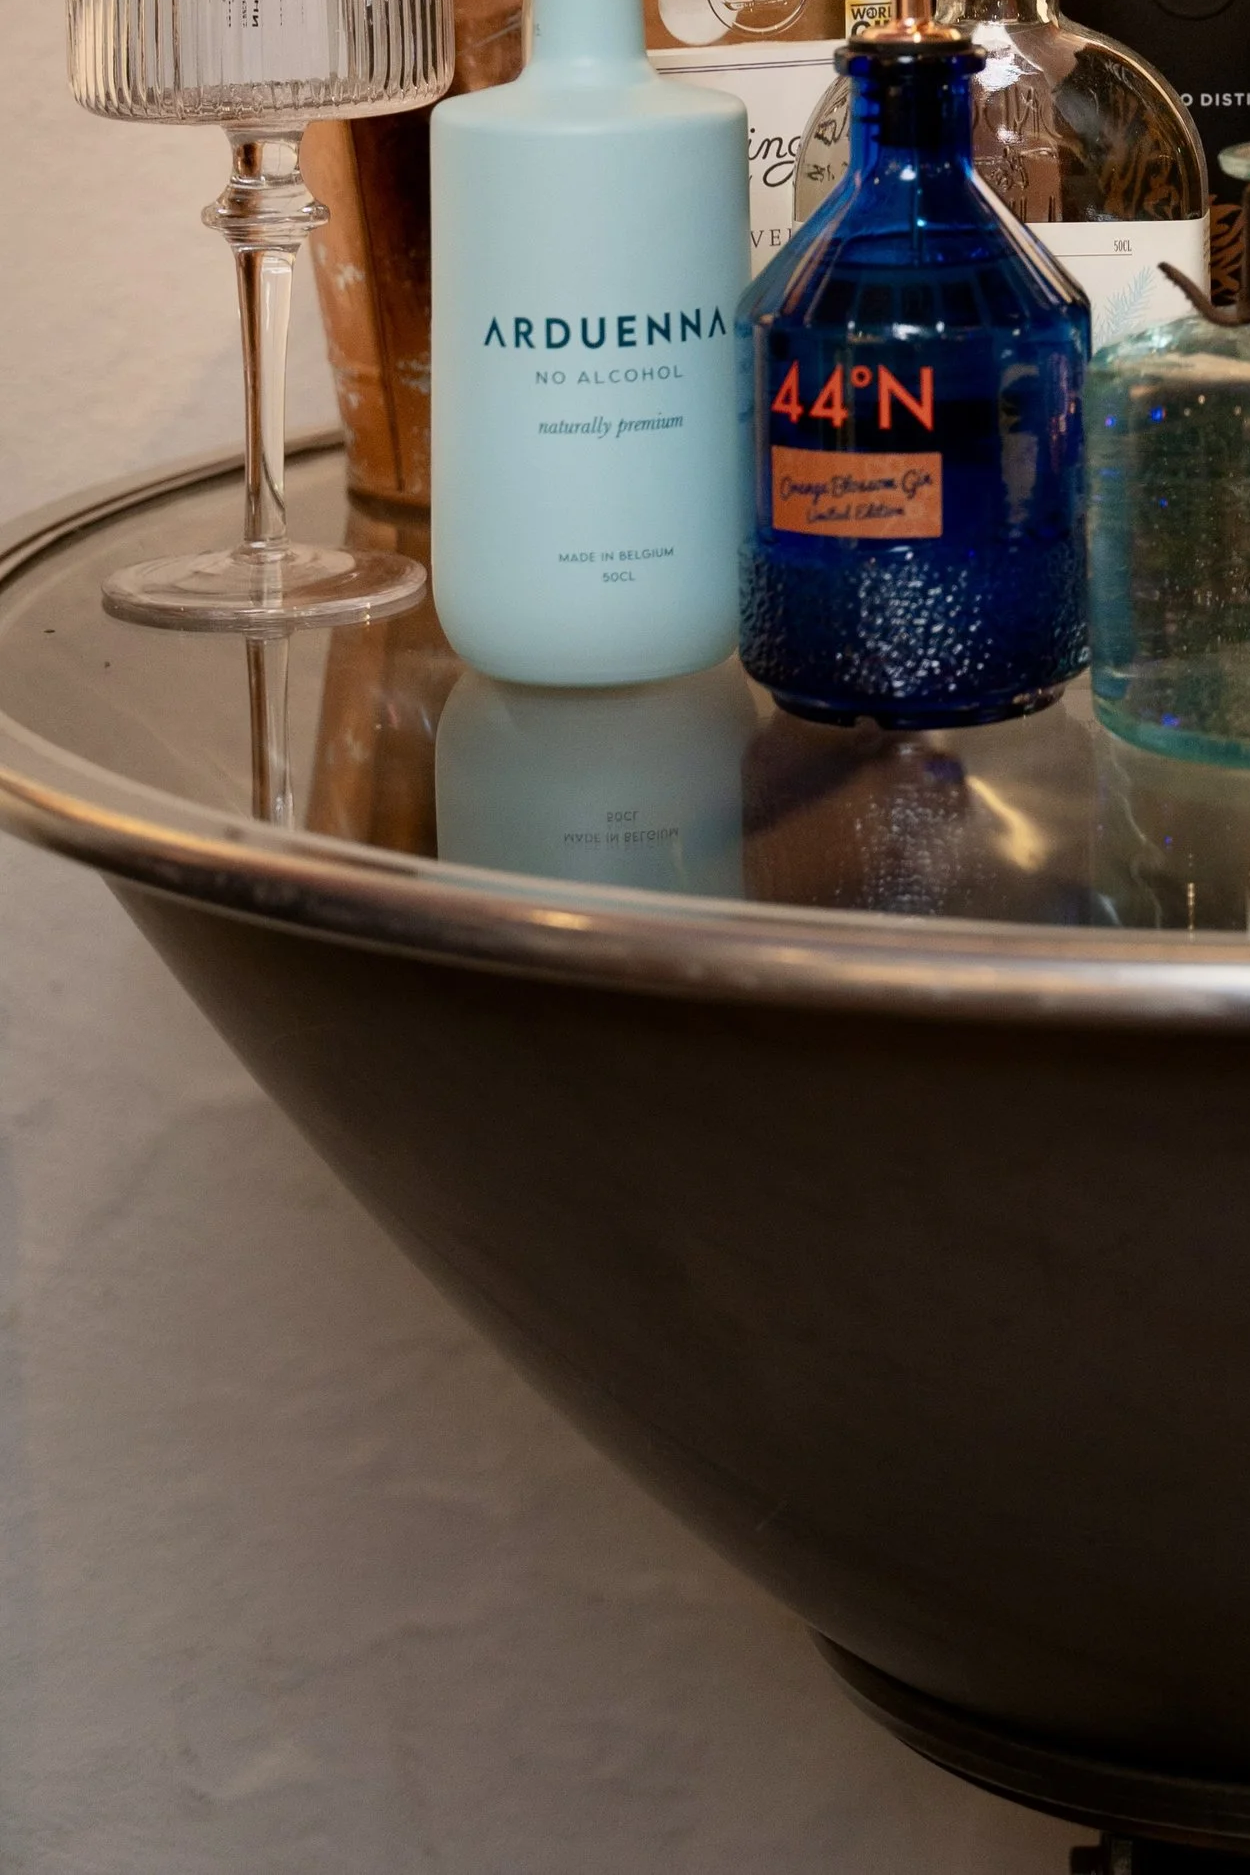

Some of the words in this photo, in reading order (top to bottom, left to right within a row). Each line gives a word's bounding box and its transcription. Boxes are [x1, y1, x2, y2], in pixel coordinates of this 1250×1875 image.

[1113, 239, 1132, 252] 50CL
[483, 305, 727, 350] ARDUENNA
[535, 371, 566, 385] NO
[577, 365, 684, 385] ALCOHOL
[771, 358, 935, 432] 44°N
[538, 415, 613, 439] naturally
[615, 412, 684, 438] premium
[558, 552, 596, 563] MADE
[601, 552, 615, 562] IN
[619, 547, 675, 561] BELGIUM
[602, 571, 636, 583] 50CL
